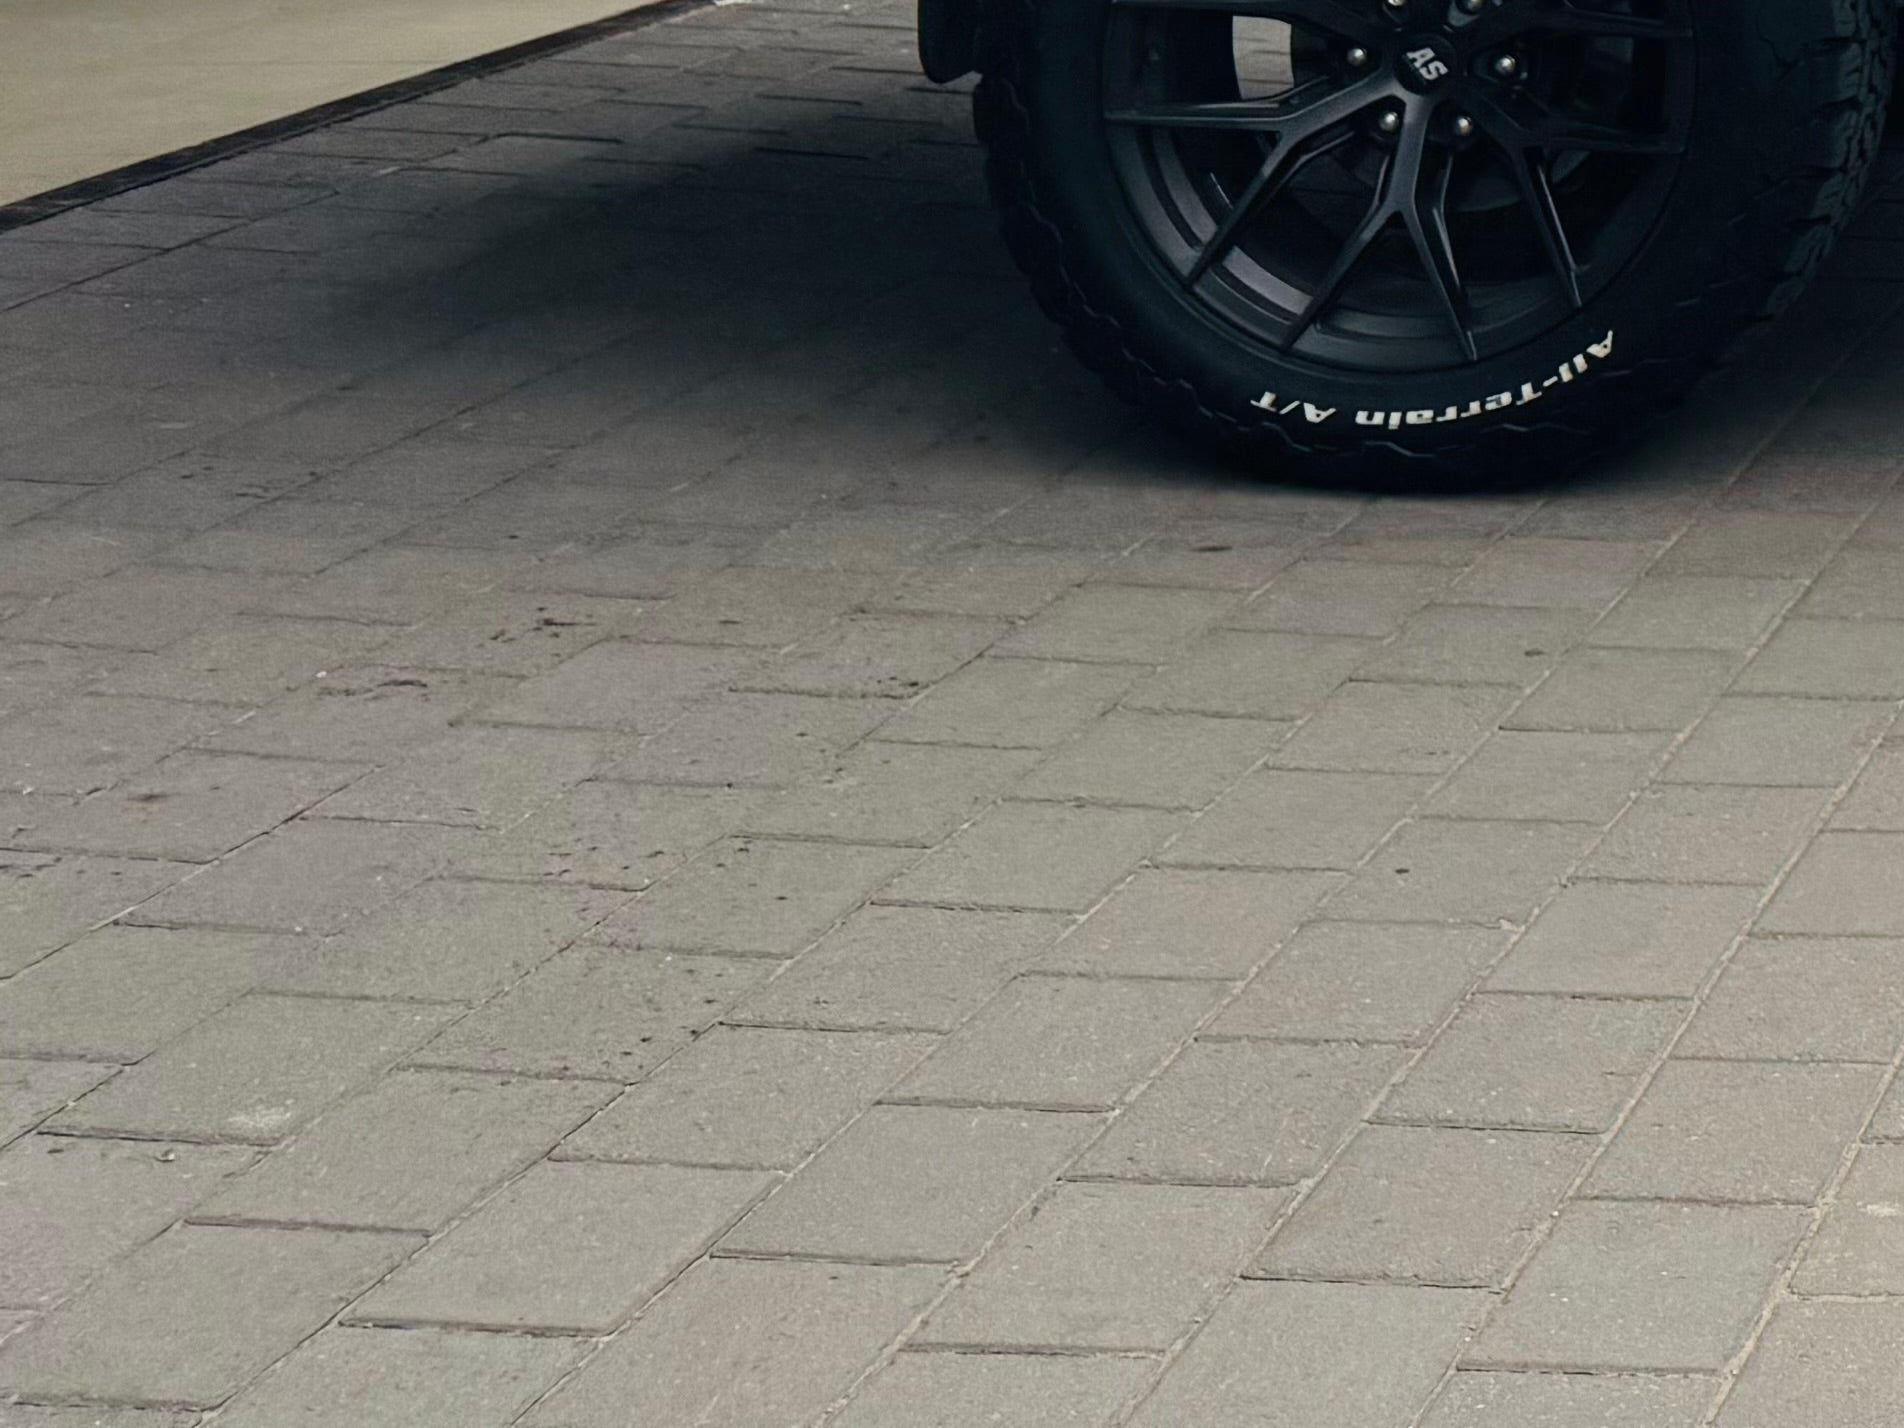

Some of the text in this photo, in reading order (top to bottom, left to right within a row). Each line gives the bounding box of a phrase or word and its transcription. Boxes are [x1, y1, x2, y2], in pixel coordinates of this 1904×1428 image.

[1405, 47, 1449, 81] AS
[1250, 329, 1614, 430] All-Terrain A/T
